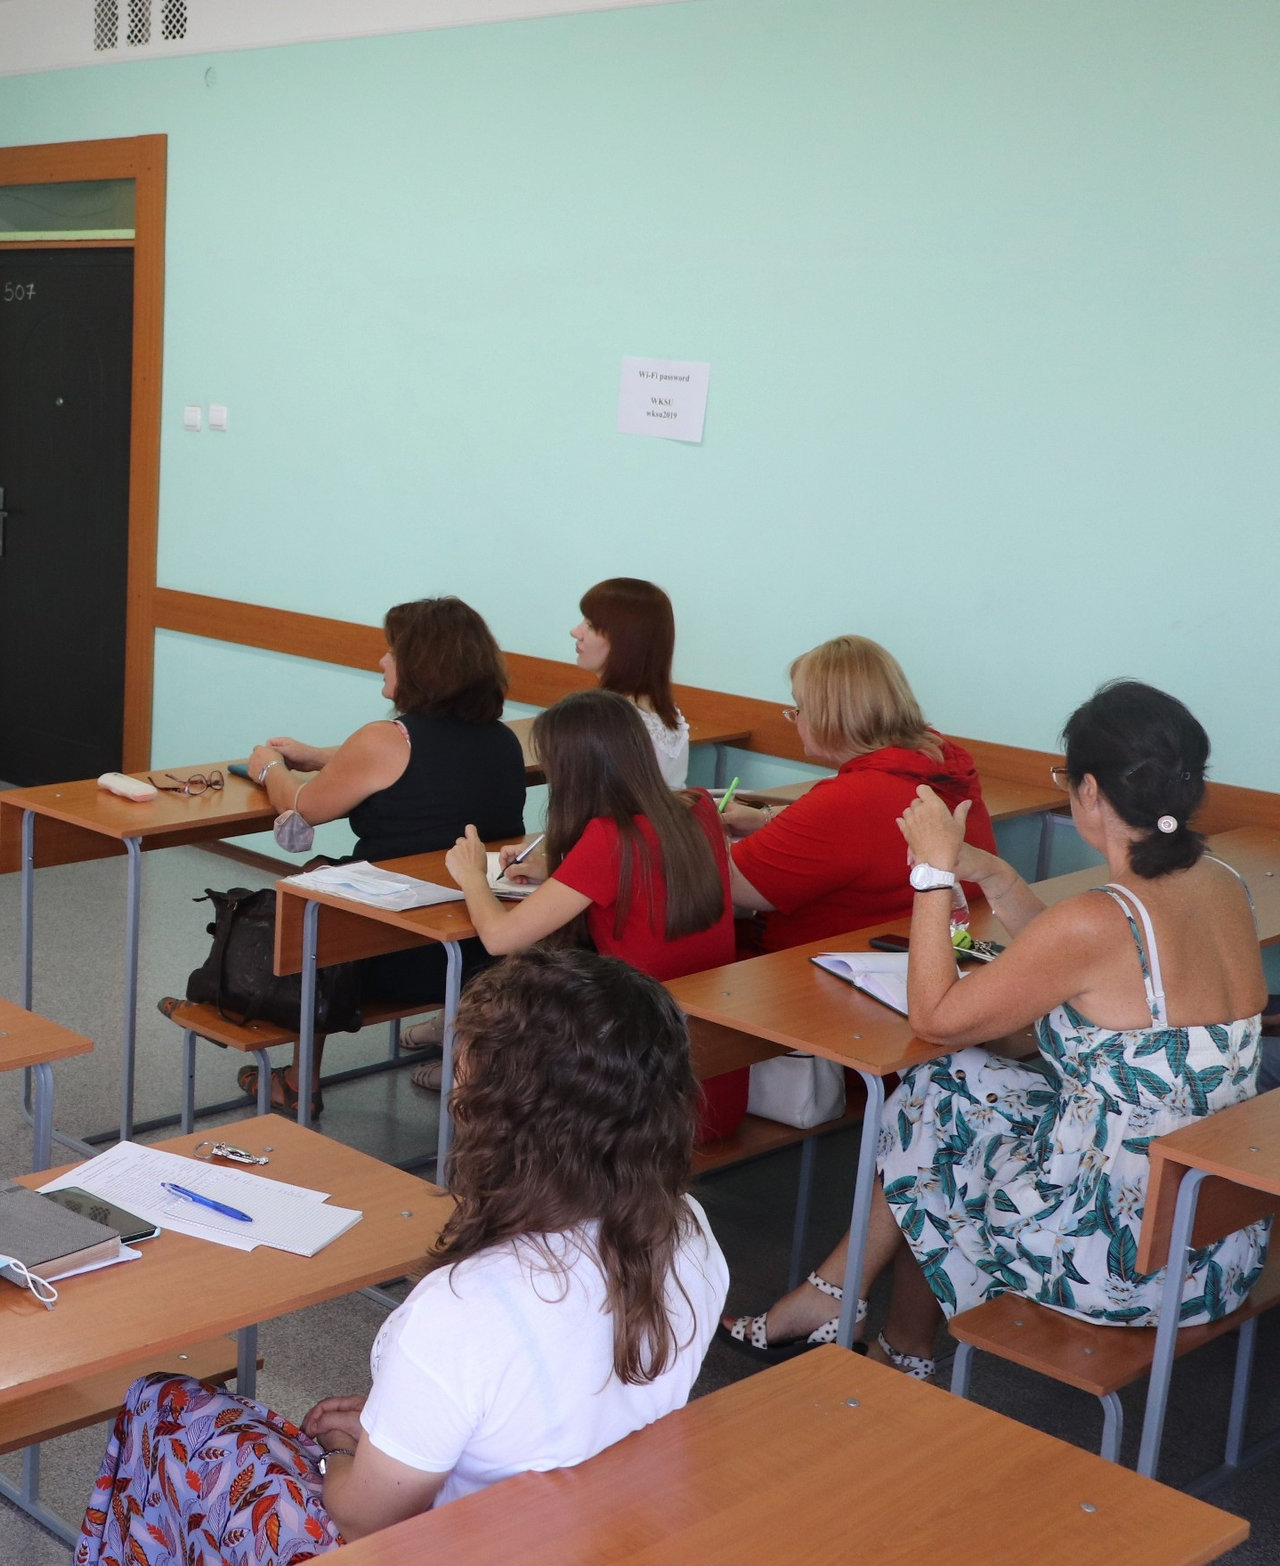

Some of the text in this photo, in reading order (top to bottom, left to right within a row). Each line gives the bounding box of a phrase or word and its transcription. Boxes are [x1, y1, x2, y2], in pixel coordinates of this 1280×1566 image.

[4, 281, 36, 301] 507
[638, 370, 690, 383] Wi-Fi password
